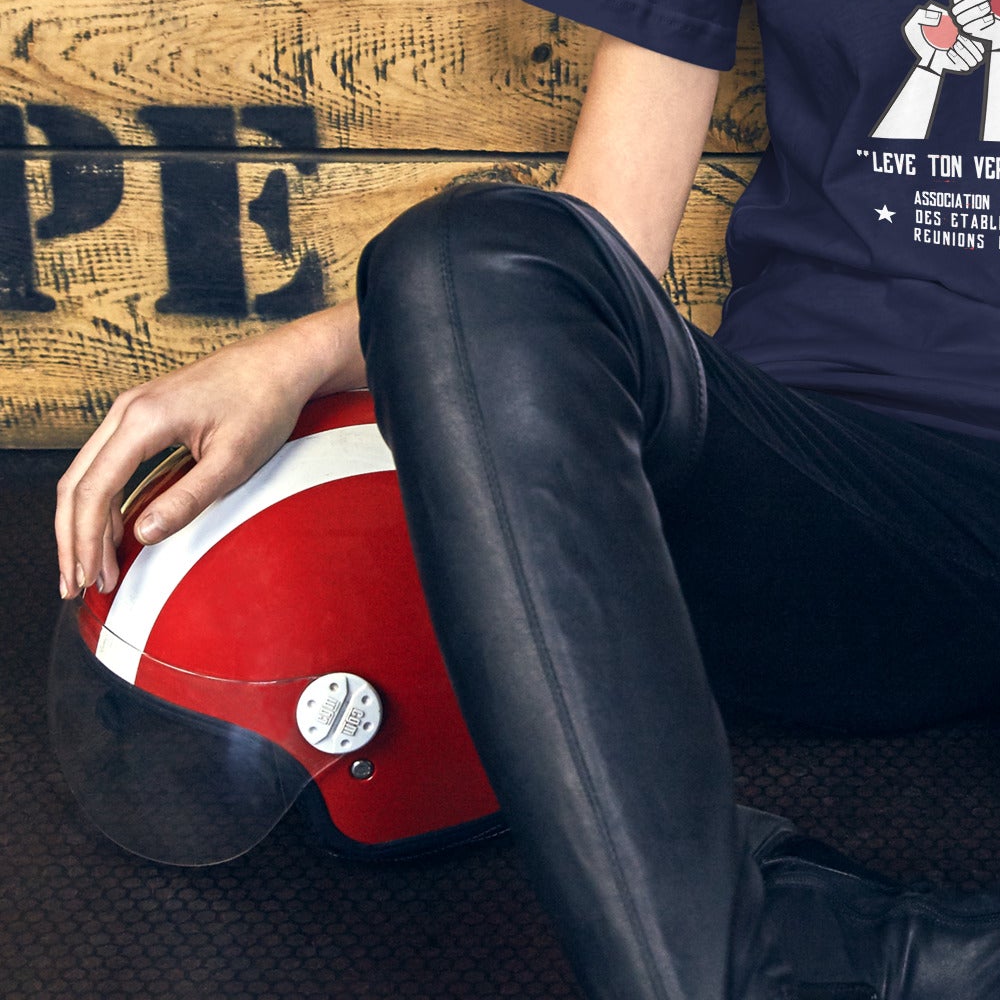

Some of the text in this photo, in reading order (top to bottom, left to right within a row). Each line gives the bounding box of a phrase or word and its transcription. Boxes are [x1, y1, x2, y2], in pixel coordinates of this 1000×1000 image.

[927, 153, 963, 179] TON
[913, 190, 991, 211] ASSOCIATION
[915, 209, 942, 227] DES
[913, 227, 985, 250] REUNIONS
